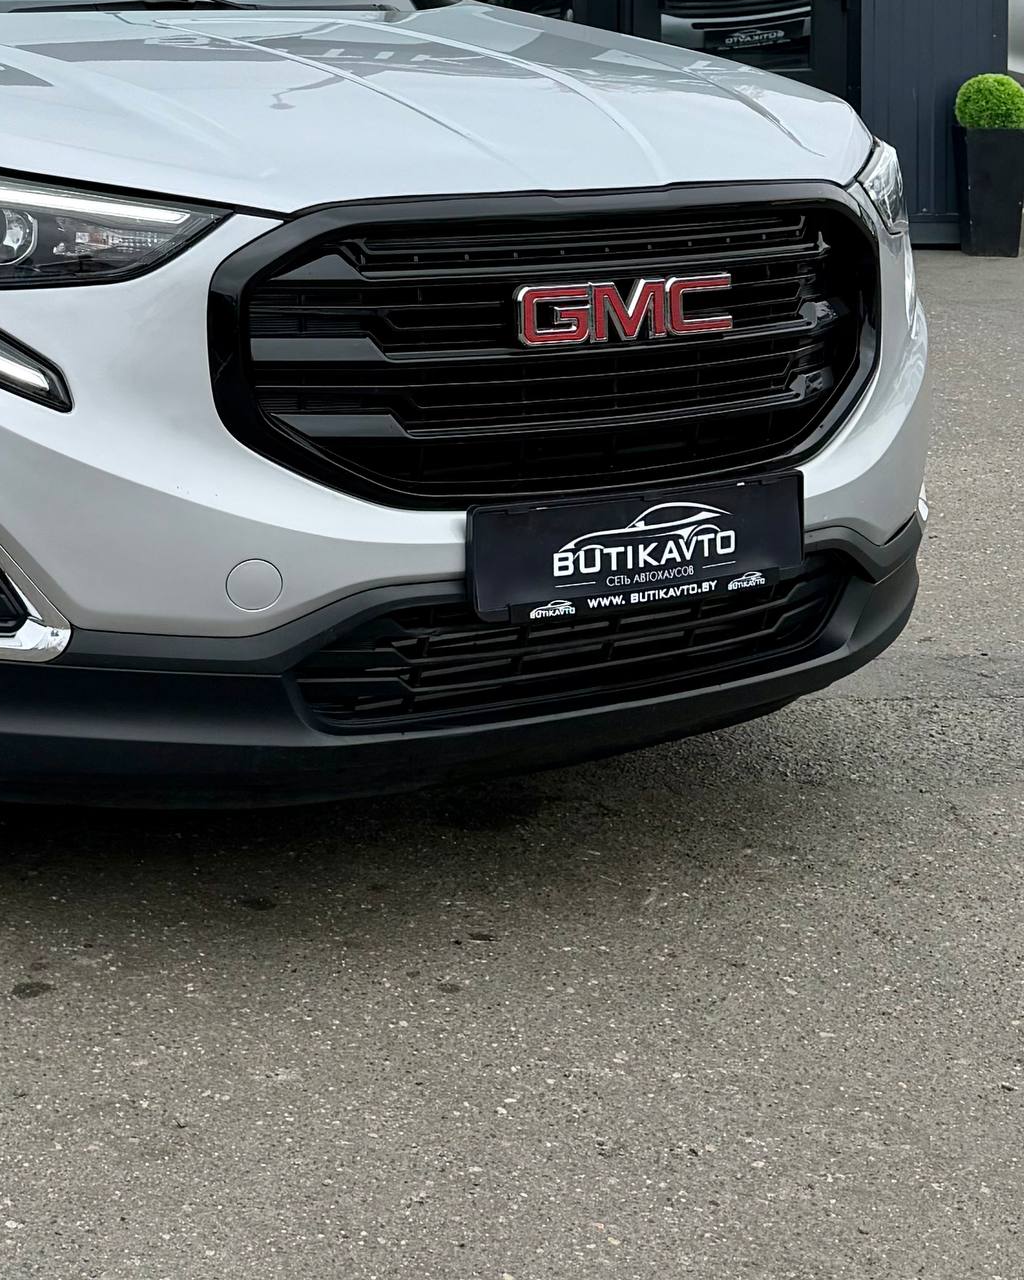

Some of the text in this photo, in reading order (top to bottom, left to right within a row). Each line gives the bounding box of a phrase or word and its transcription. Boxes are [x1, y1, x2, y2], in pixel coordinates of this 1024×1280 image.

[515, 272, 733, 348] GMC
[552, 529, 736, 576] BUTIKAVTO
[606, 565, 694, 587] СЕТЬ АВТОХАУСОВ
[727, 577, 766, 591] BUTIKAVTO
[587, 580, 718, 609] WWW. BUTIKAVTO.BY
[529, 606, 576, 619] BUTIKAVTO
